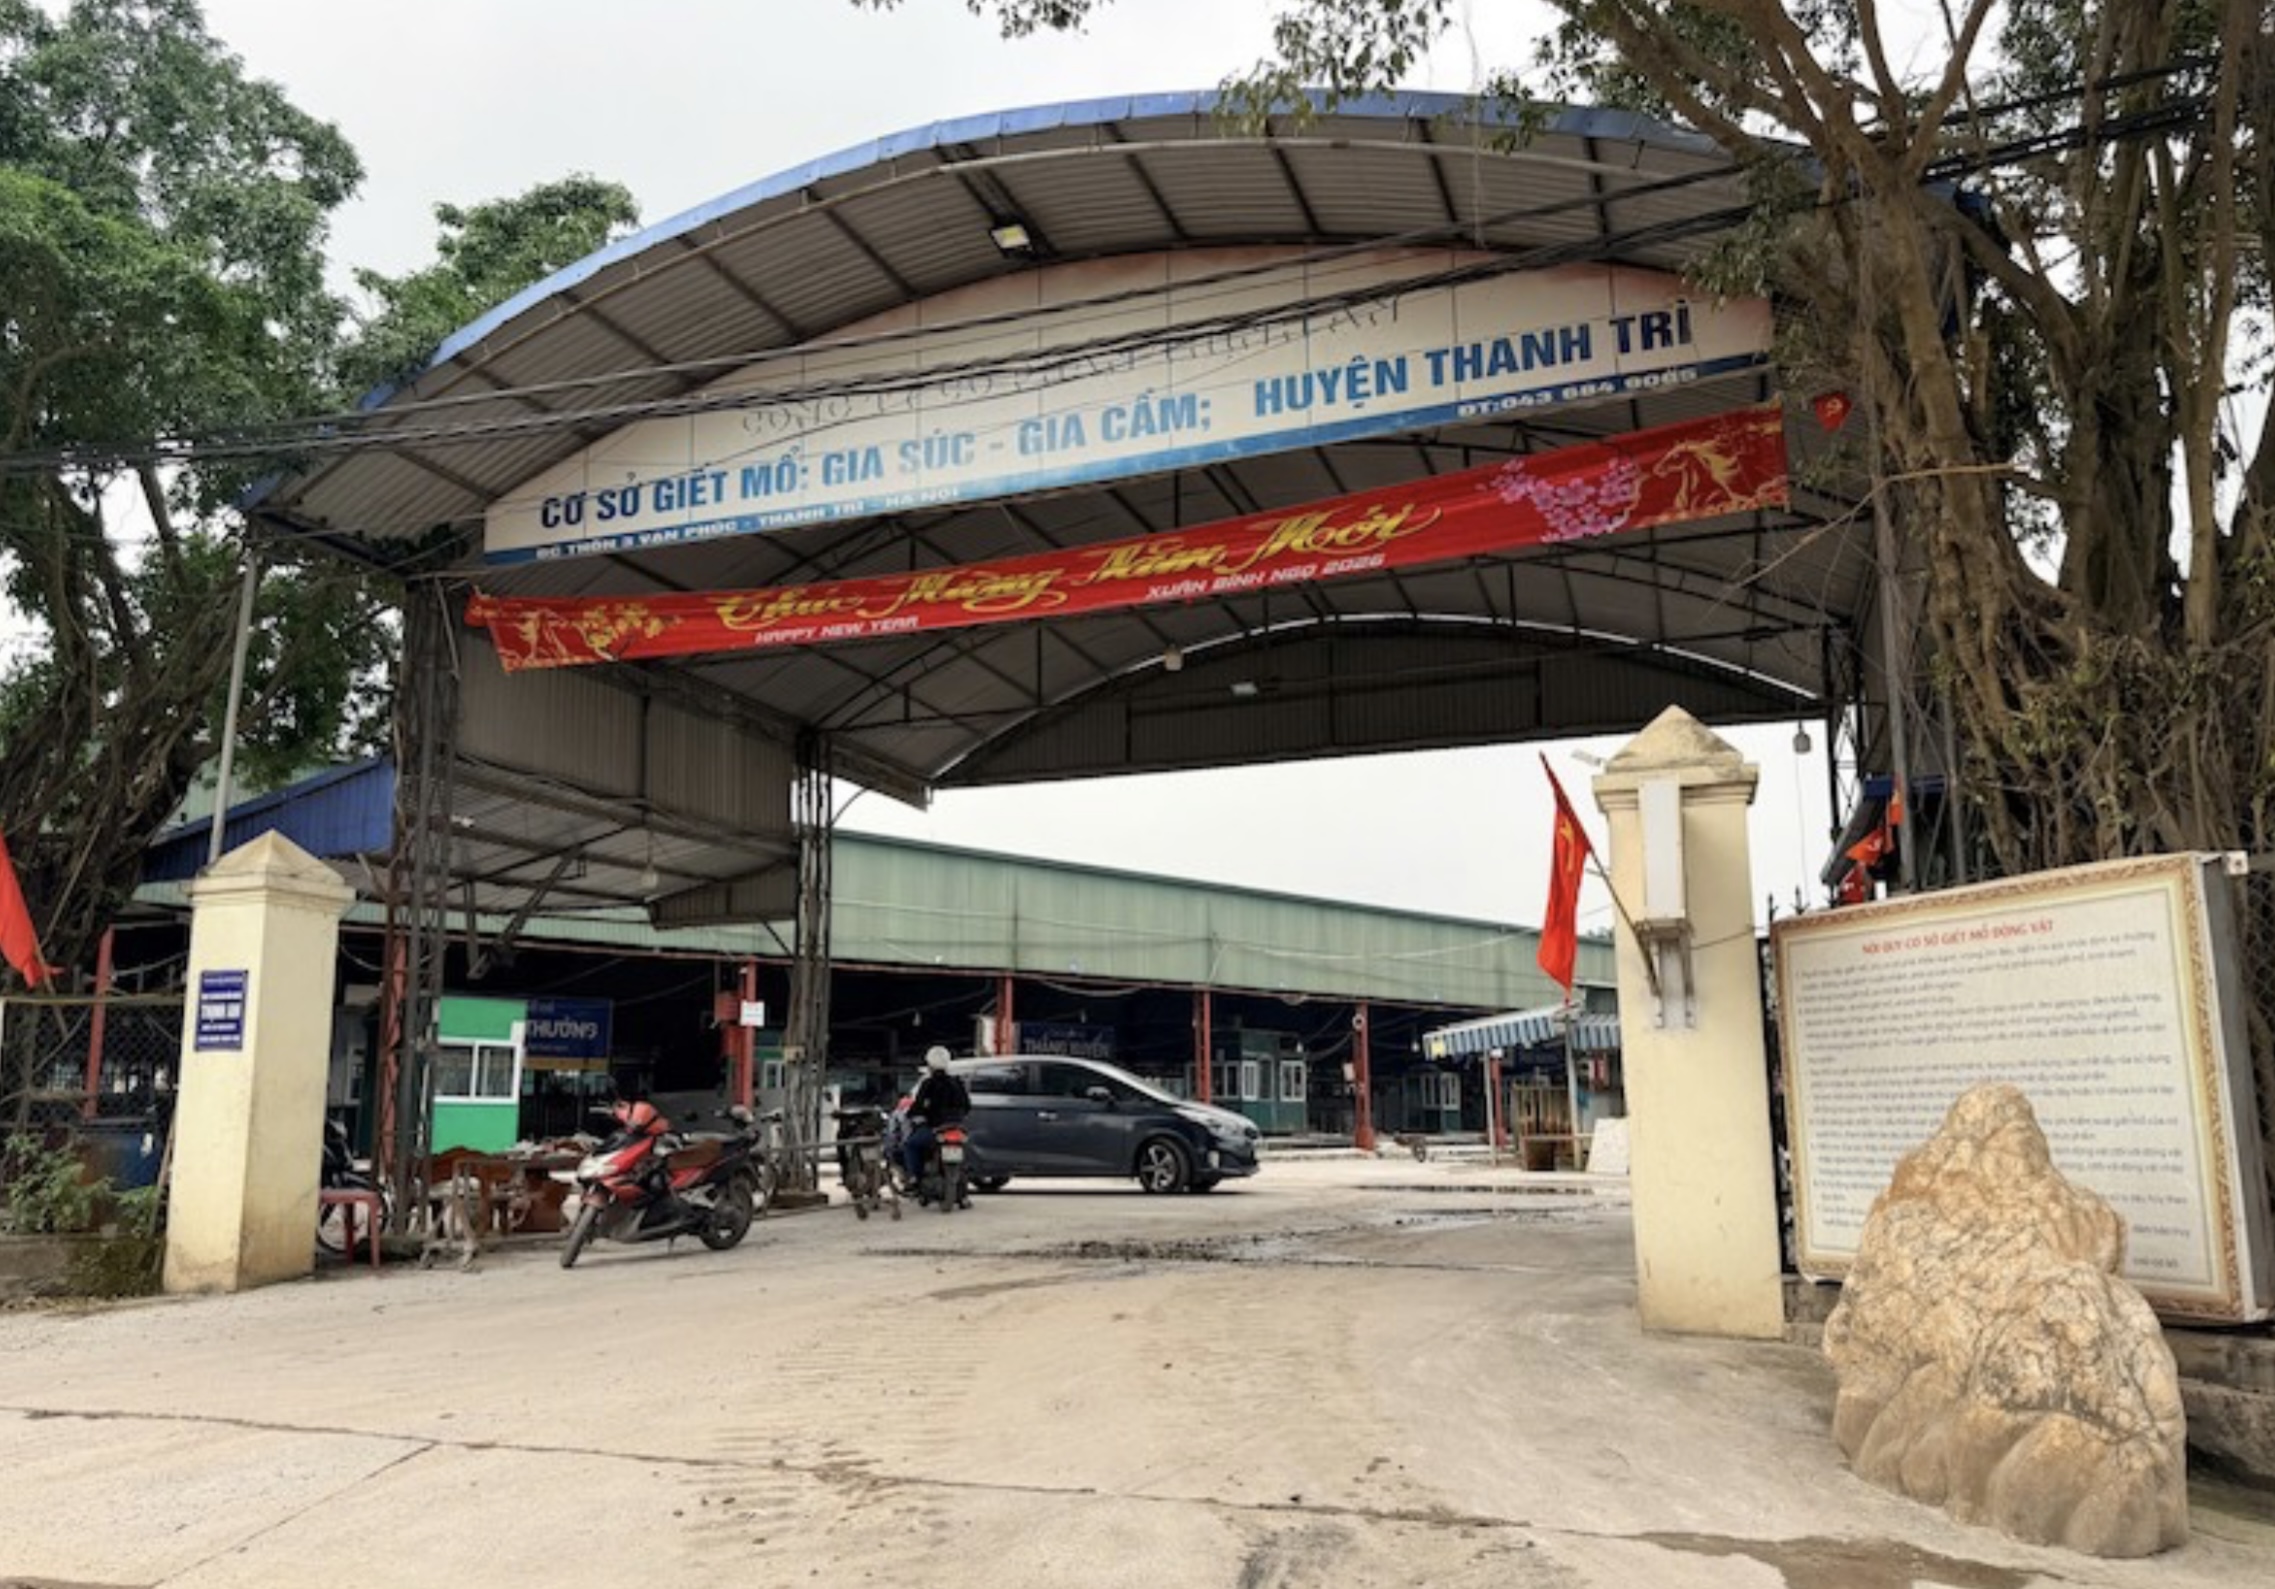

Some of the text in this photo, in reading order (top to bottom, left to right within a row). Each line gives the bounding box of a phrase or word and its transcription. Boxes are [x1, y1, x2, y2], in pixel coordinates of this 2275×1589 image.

[541, 491, 588, 528] CƠ
[597, 471, 643, 520] SỞ
[653, 465, 728, 513] GIẾT
[821, 446, 885, 486] GIA
[900, 428, 977, 474] SÚC
[1018, 413, 1087, 455] GIA
[1101, 387, 1212, 443] CẦM;
[1255, 355, 1409, 418] HUYỆN
[1424, 323, 1593, 387] THANH
[1609, 299, 1693, 354] TRÌ
[758, 506, 828, 527] THANH
[1321, 552, 1386, 575] 2026
[755, 615, 920, 645] HAPPY NEW YEAR
